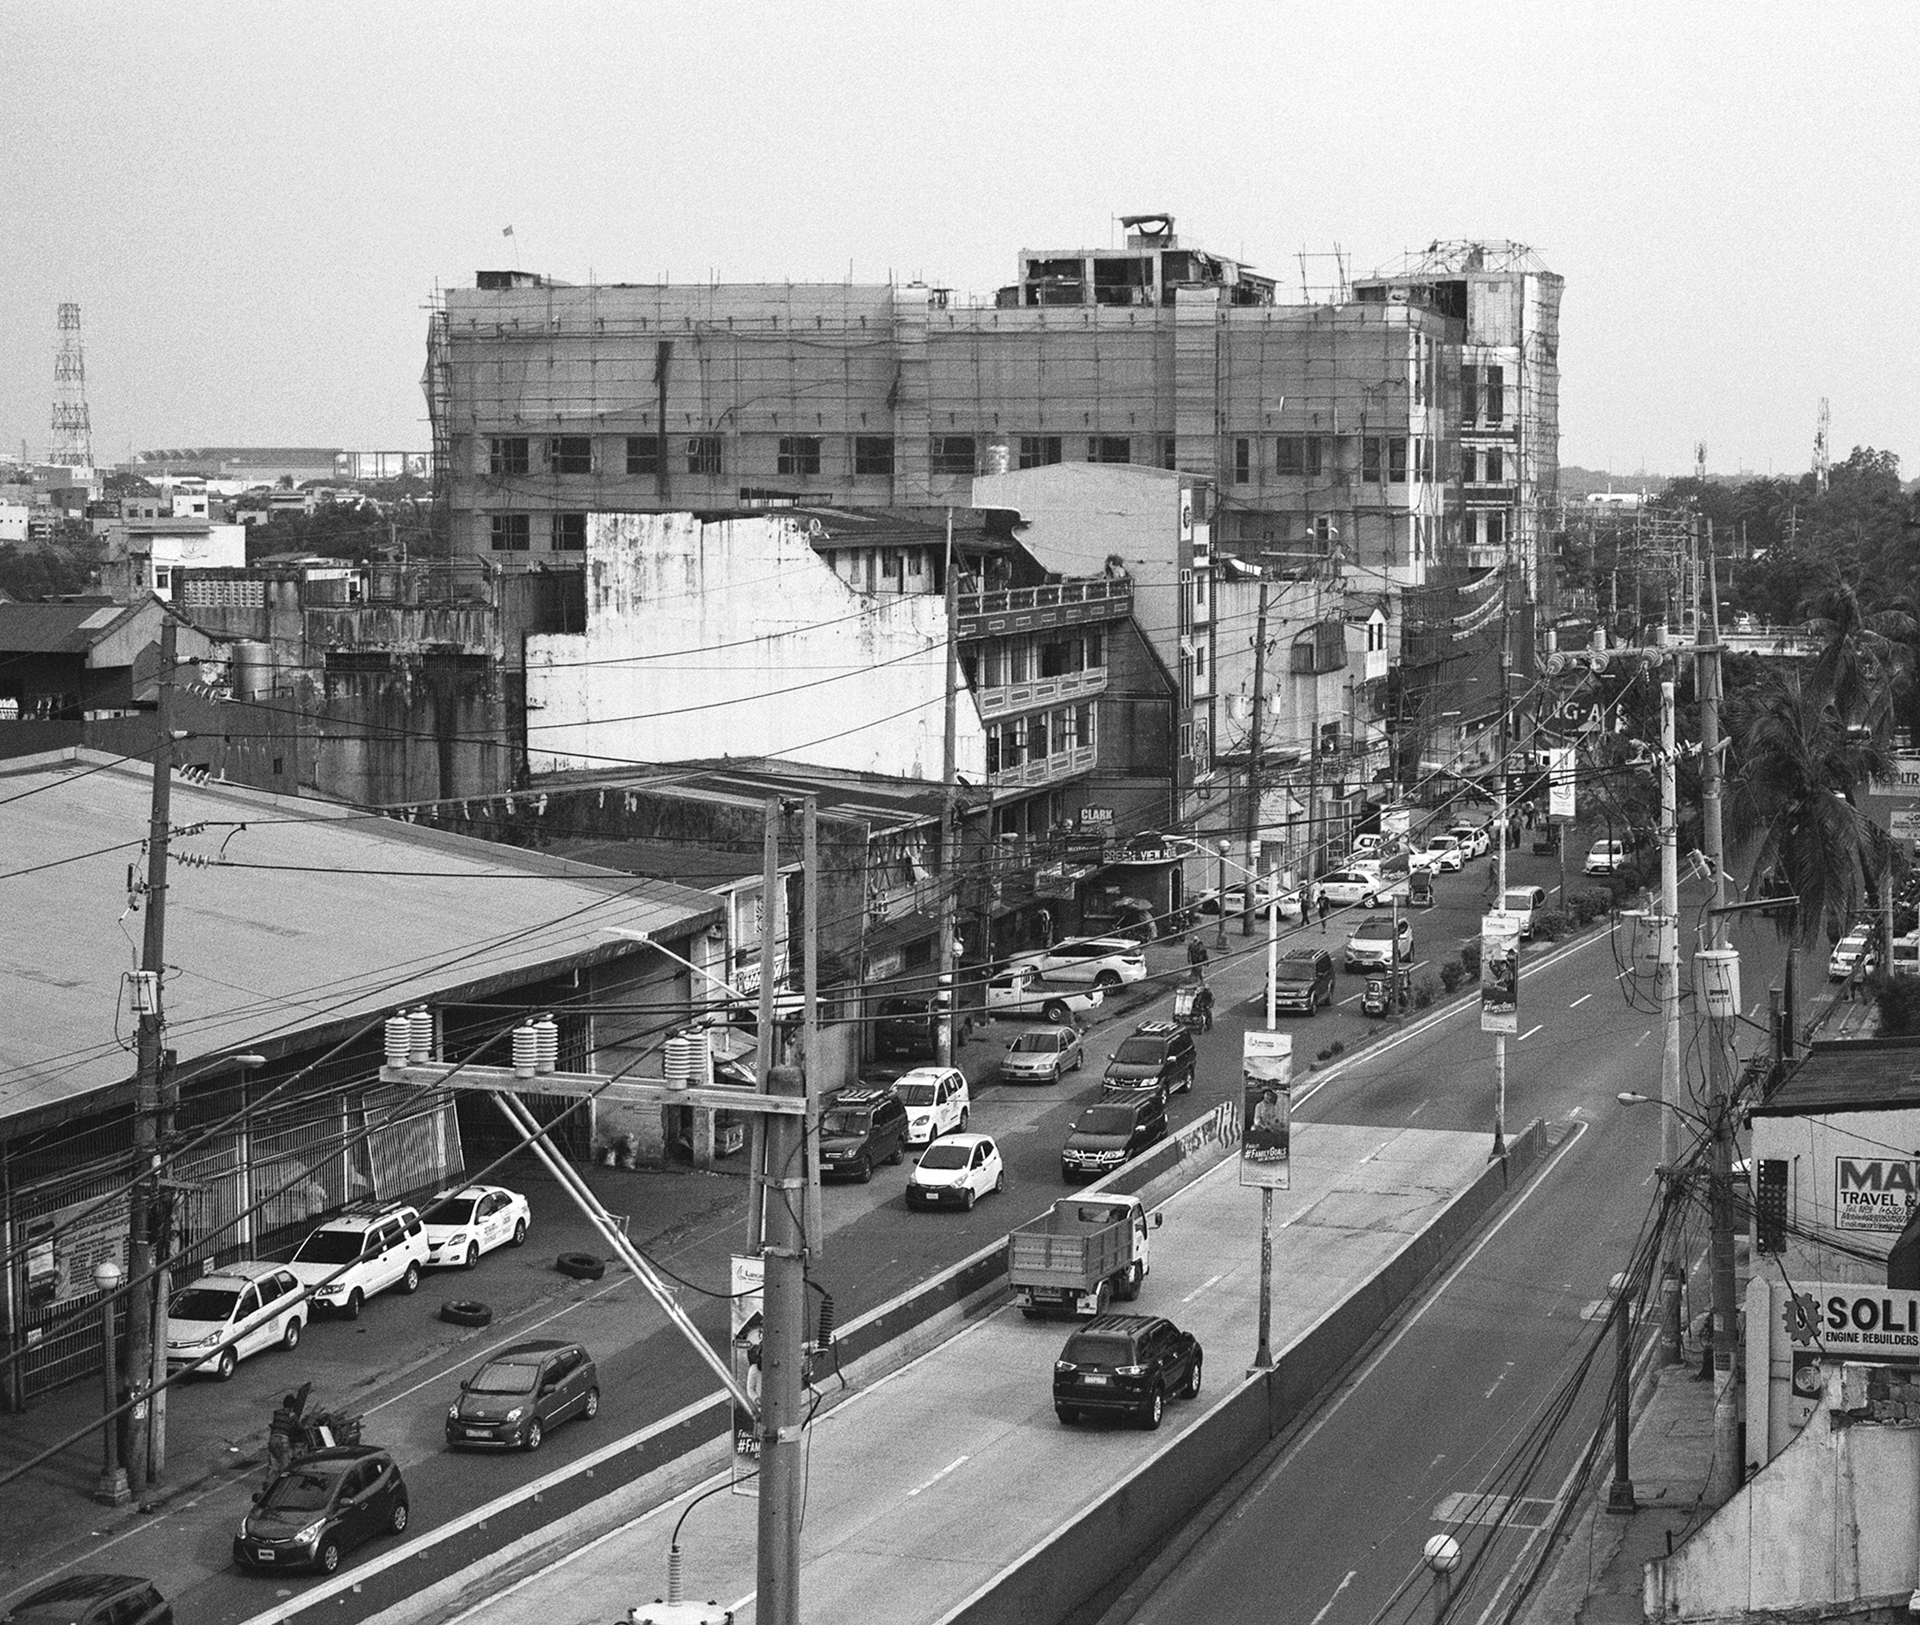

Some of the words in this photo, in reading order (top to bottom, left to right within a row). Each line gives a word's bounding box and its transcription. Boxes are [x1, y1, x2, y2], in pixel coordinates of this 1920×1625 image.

[1081, 808, 1113, 820] CLARK
[1141, 850, 1161, 860] VIEW
[1840, 1161, 1916, 1191] MA
[1841, 1191, 1899, 1206] TRAVEL
[1904, 1195, 1916, 1207] &
[1827, 1296, 1917, 1332] SOLI
[1826, 1332, 1860, 1343] ENGINE
[1862, 1333, 1919, 1346] REBUILDERS
[737, 1439, 760, 1454] #FAM
